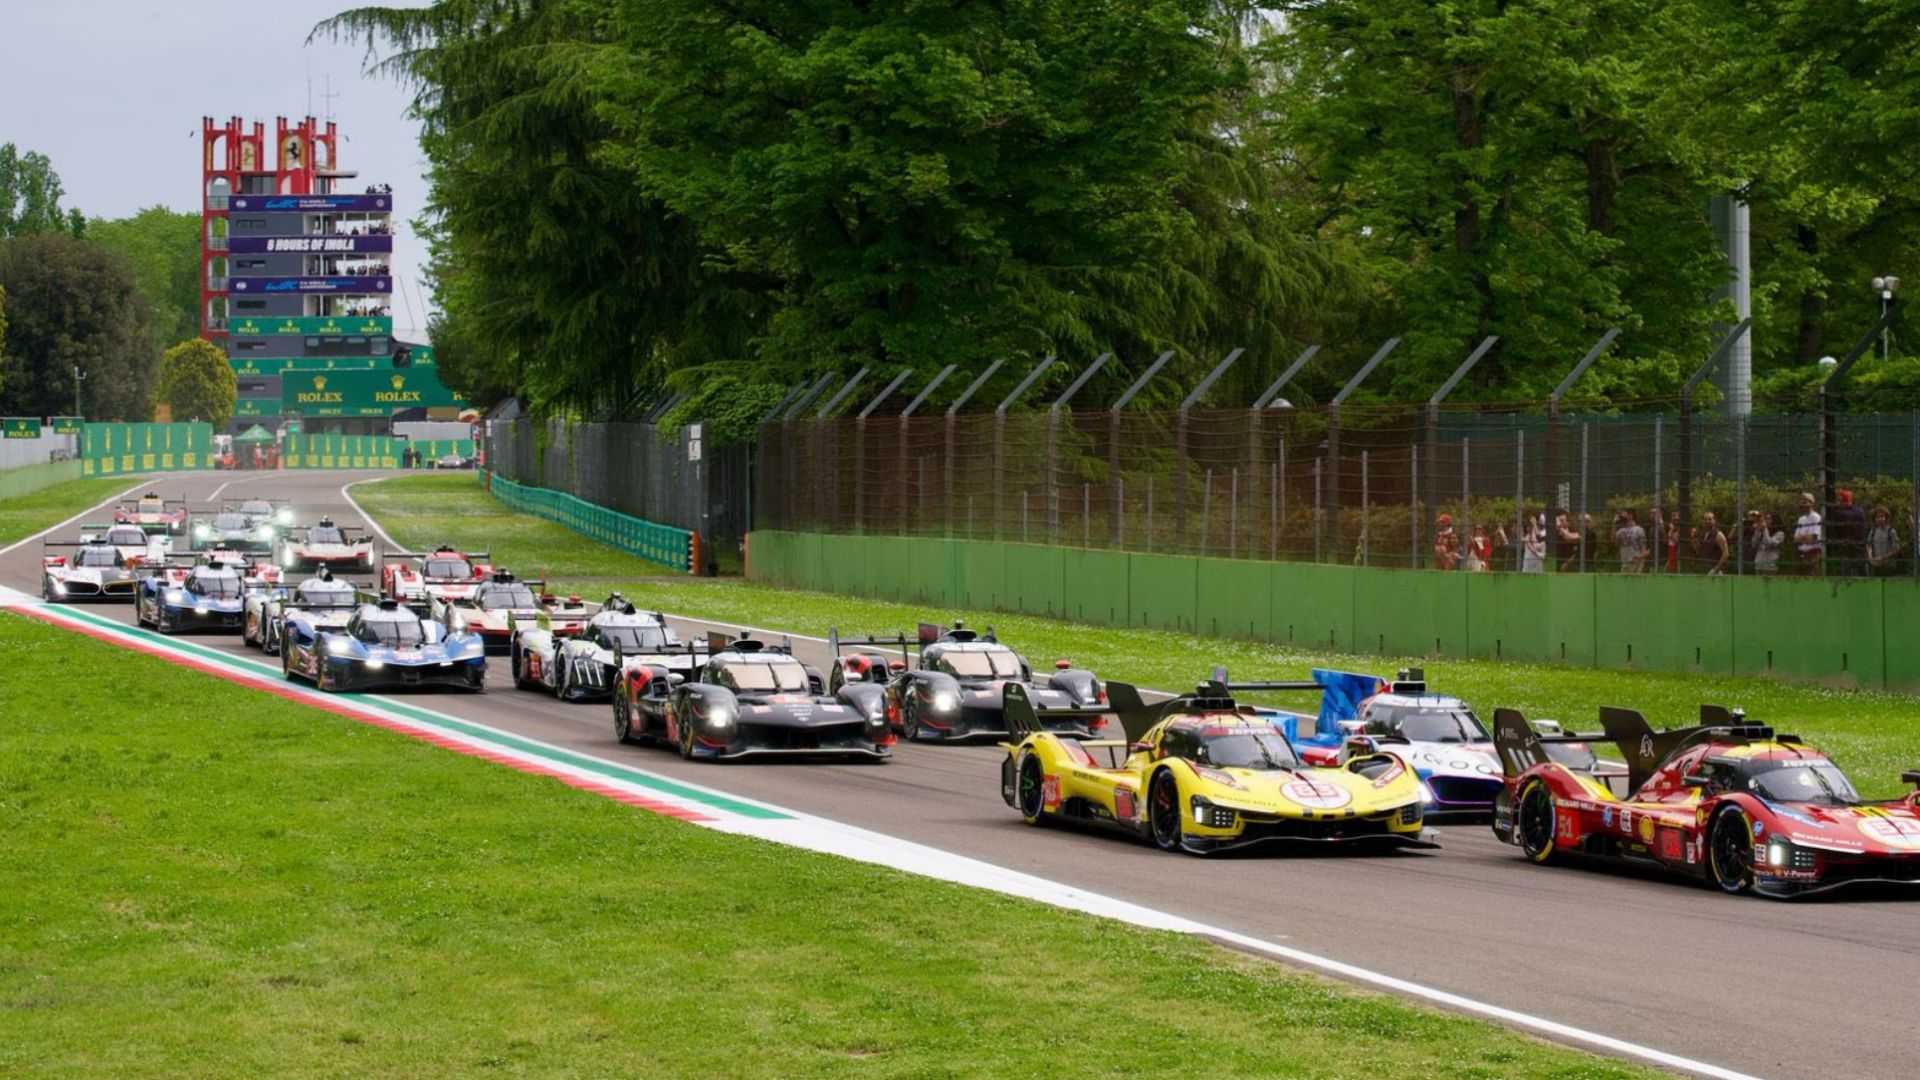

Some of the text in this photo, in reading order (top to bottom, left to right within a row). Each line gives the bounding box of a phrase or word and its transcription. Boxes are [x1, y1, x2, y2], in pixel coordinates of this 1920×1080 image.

[267, 238, 355, 251] 6 HOURS OF IMOLA
[298, 392, 343, 402] ROLEX
[375, 391, 421, 402] ROLEX
[1559, 815, 1573, 838] 51
[1792, 832, 1833, 843] RICHARD
[1783, 869, 1817, 877] V-Power
